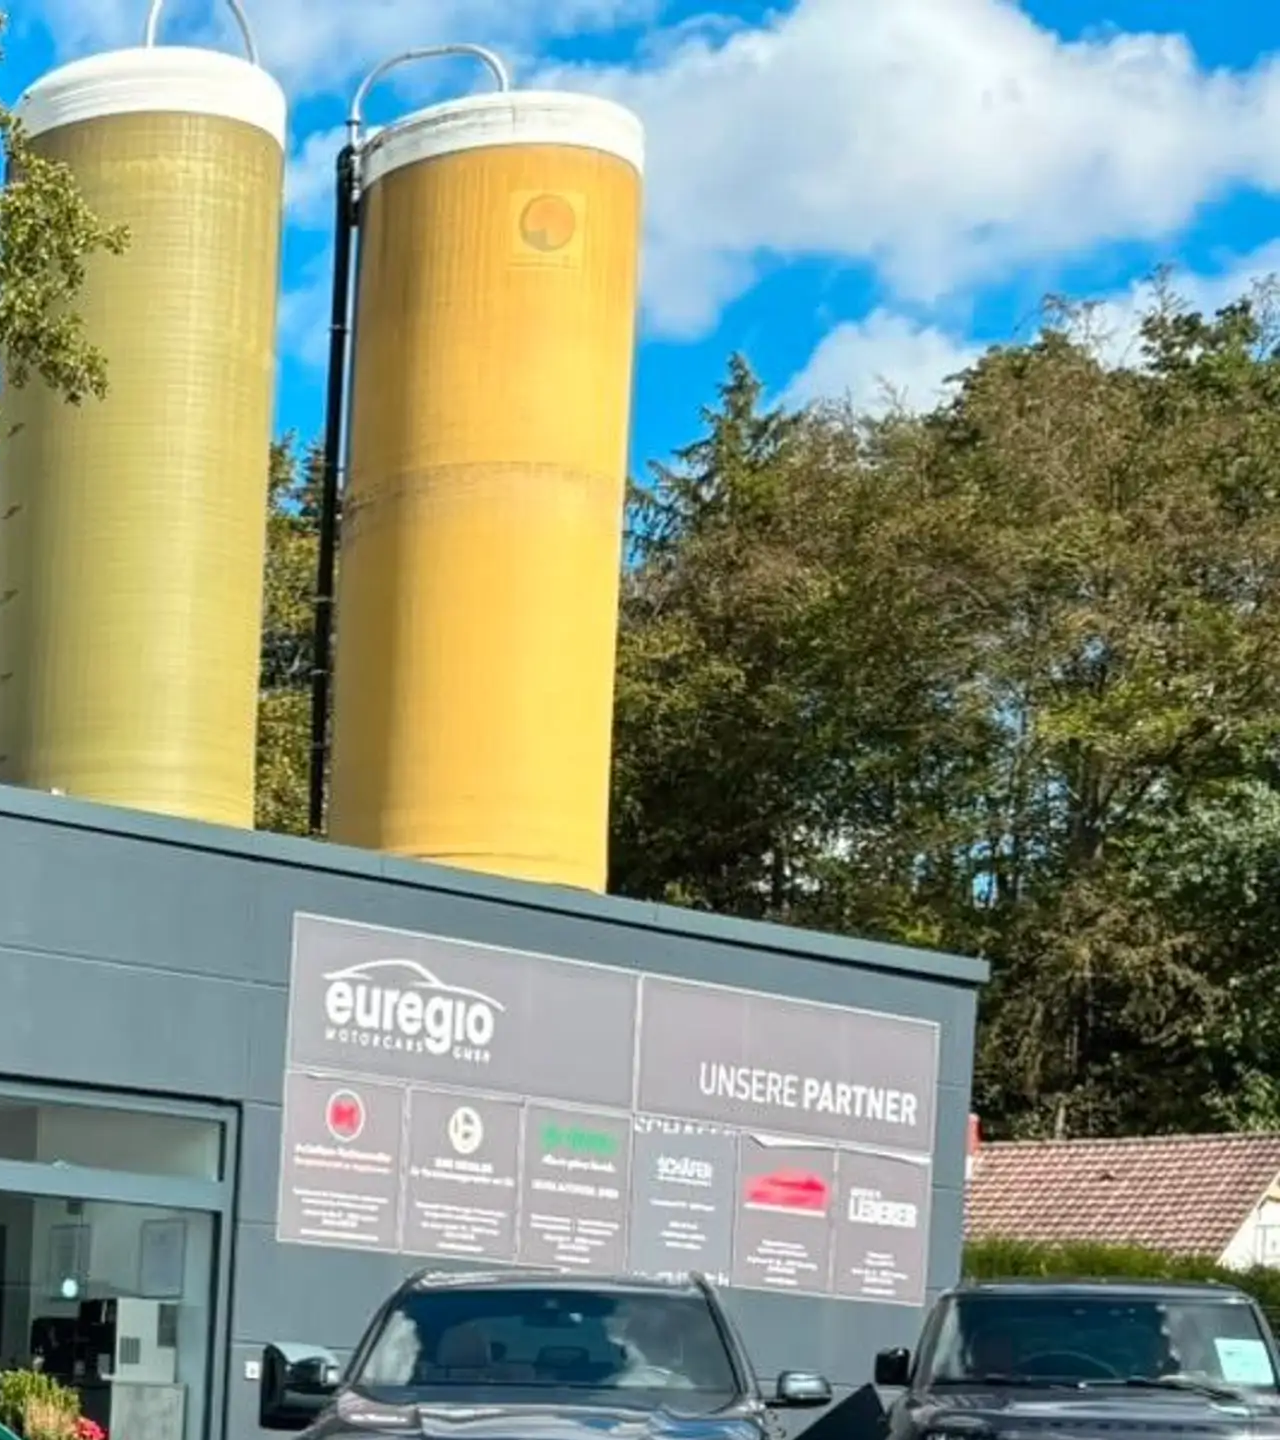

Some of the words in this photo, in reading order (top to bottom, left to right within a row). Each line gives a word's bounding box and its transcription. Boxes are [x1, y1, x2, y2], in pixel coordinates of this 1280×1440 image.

[325, 981, 495, 1055] euregio
[700, 1062, 800, 1108] UNSERE
[803, 1078, 919, 1127] PARTNER
